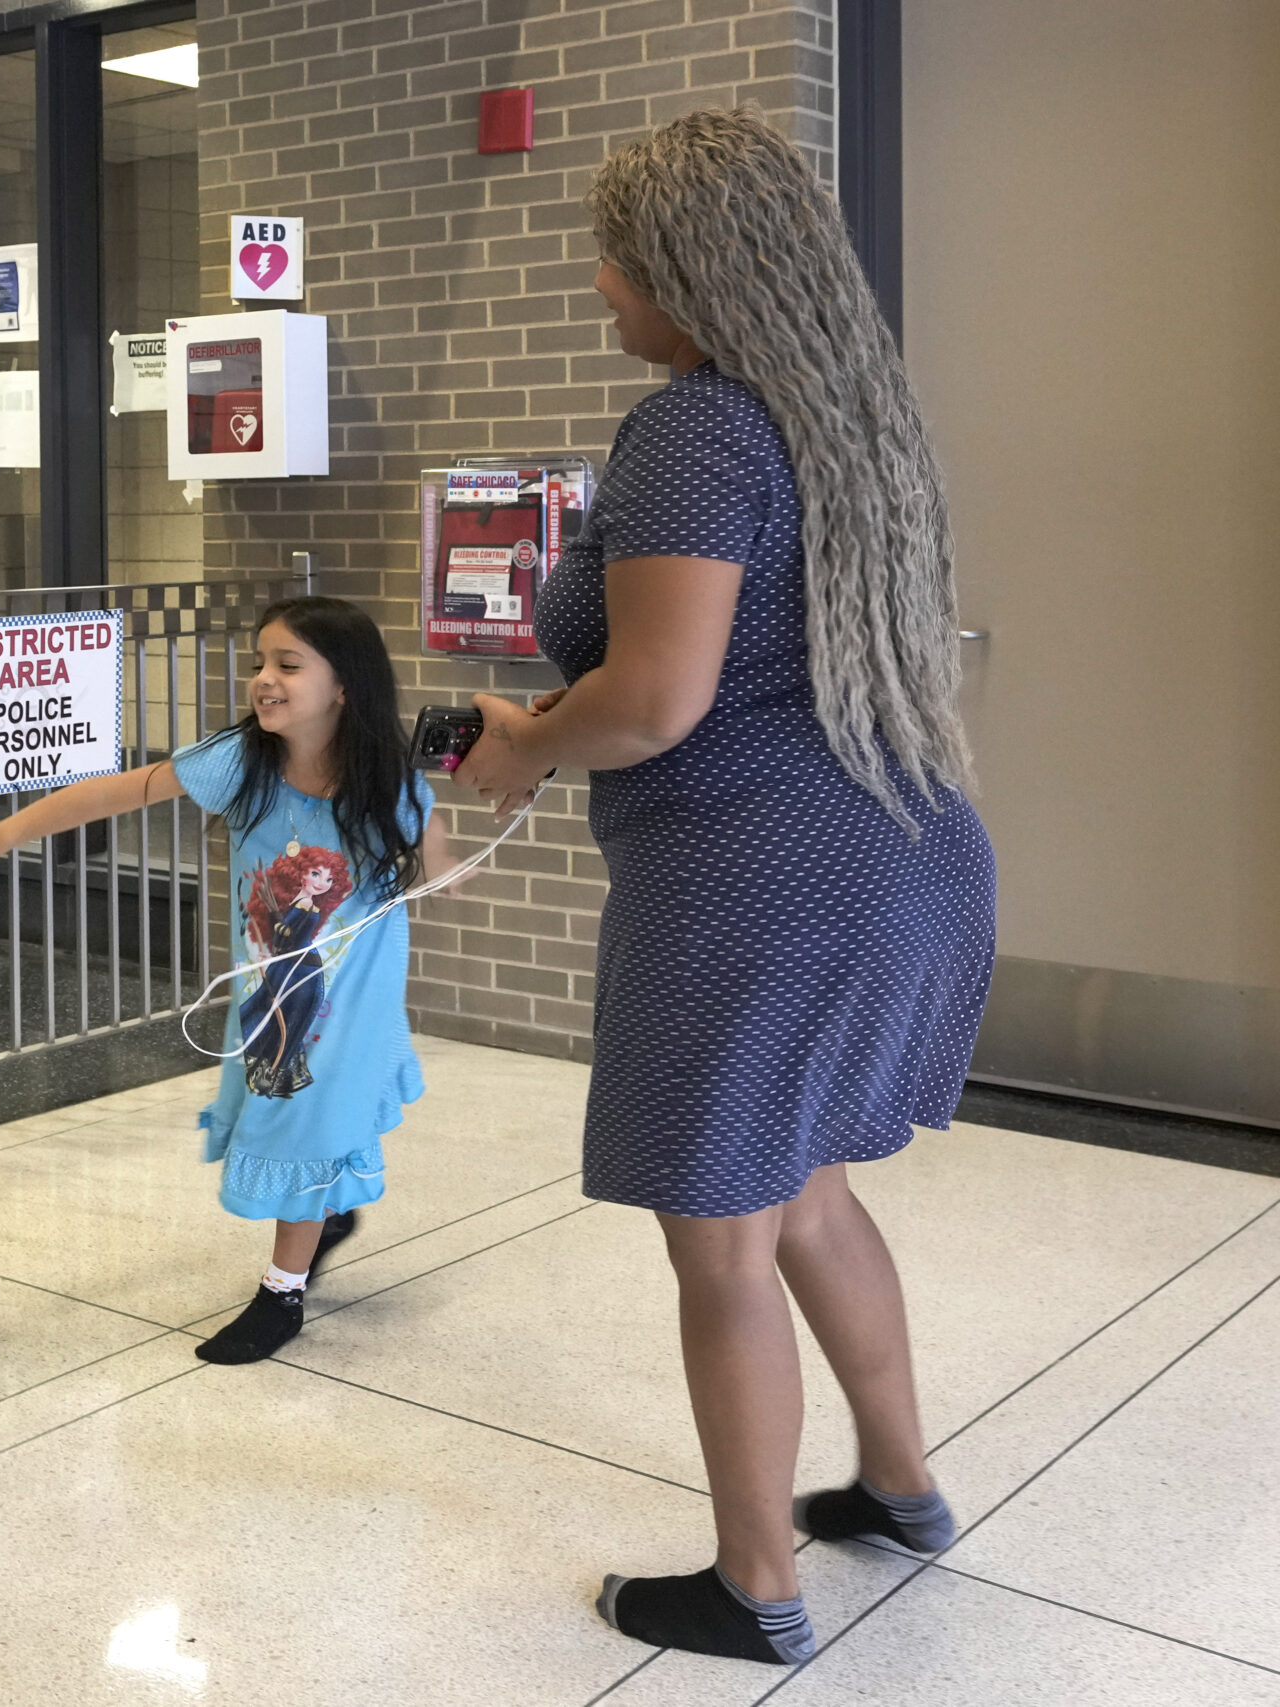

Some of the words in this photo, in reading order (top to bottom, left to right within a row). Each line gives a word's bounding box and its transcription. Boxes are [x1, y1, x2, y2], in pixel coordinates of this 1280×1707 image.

[242, 222, 286, 242] AED
[130, 341, 167, 355] NOTICE
[189, 342, 260, 359] DEFIBRILLATOR
[450, 476, 473, 488] SAFE
[475, 476, 516, 488] CHICAGO
[550, 489, 559, 549] BLEEDING
[480, 551, 507, 559] CONTROL
[430, 620, 472, 634] BLEEDING
[474, 622, 516, 636] CONTROL
[517, 624, 533, 637] KIT
[4, 753, 62, 781] ONLY
